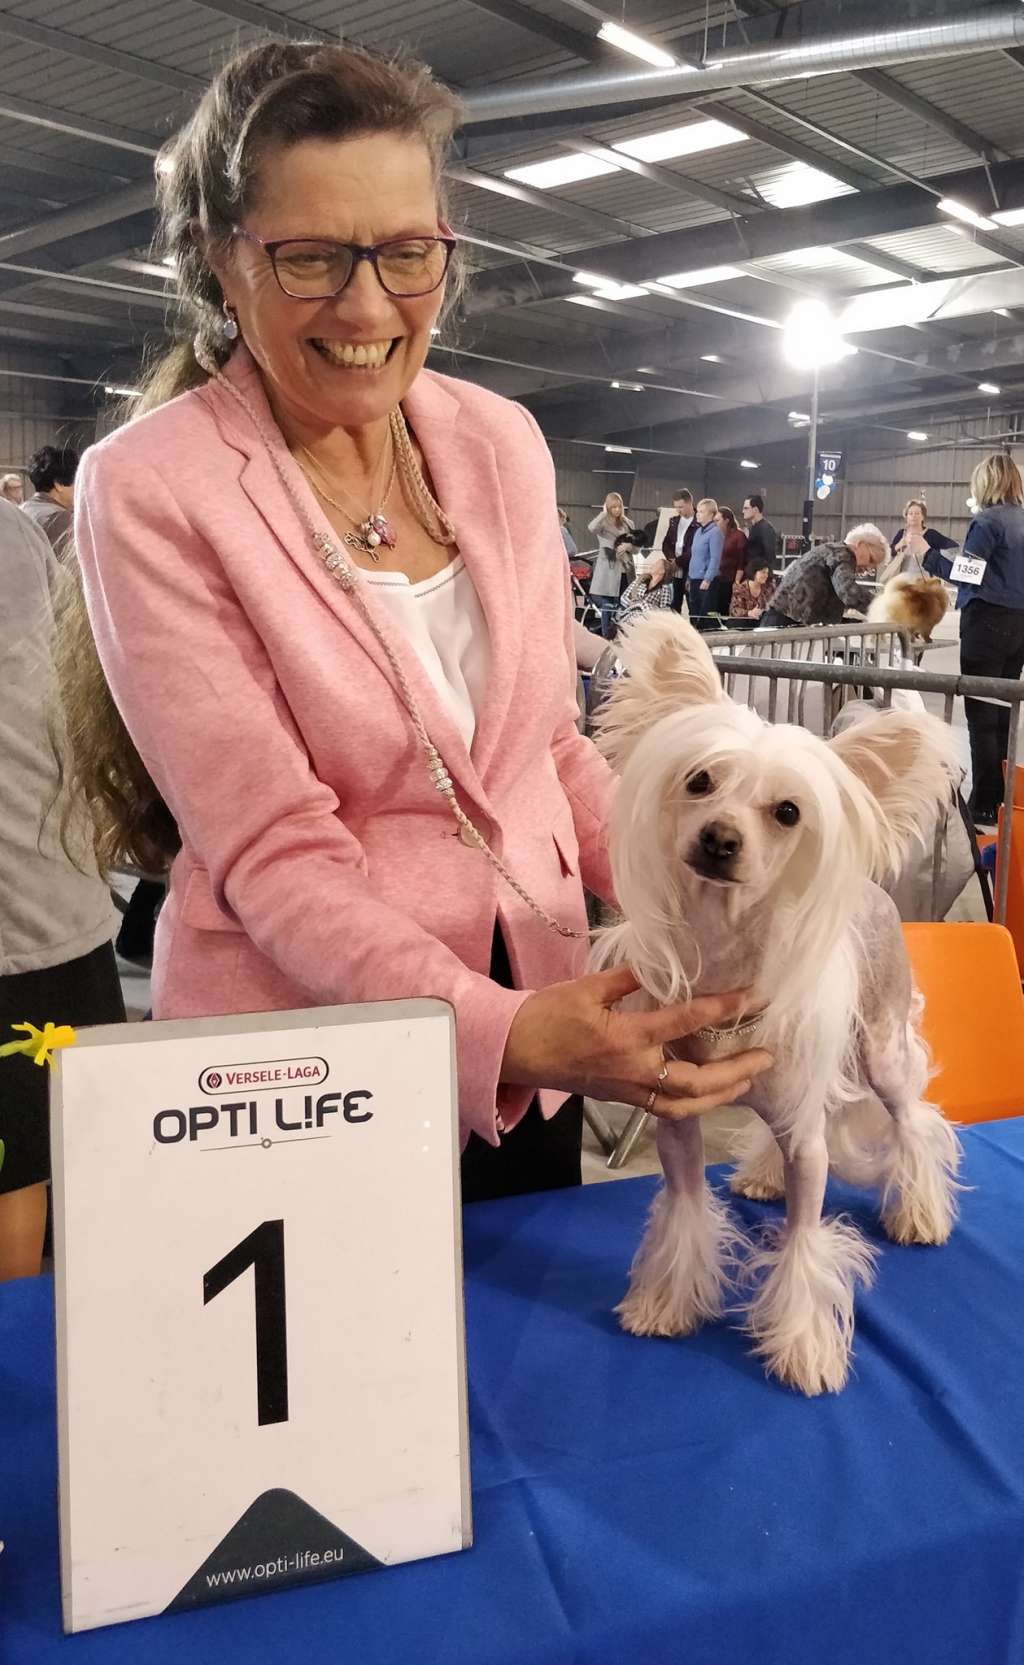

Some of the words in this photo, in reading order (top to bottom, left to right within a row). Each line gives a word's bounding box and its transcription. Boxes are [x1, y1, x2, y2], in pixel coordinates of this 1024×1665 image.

[823, 459, 836, 471] 10
[957, 564, 980, 576] 1356
[226, 1065, 321, 1086] VERSELE-LAGA
[153, 1101, 258, 1144] OPTI
[203, 1219, 289, 1426] 1
[206, 1547, 344, 1588] www.opti-life.eu
